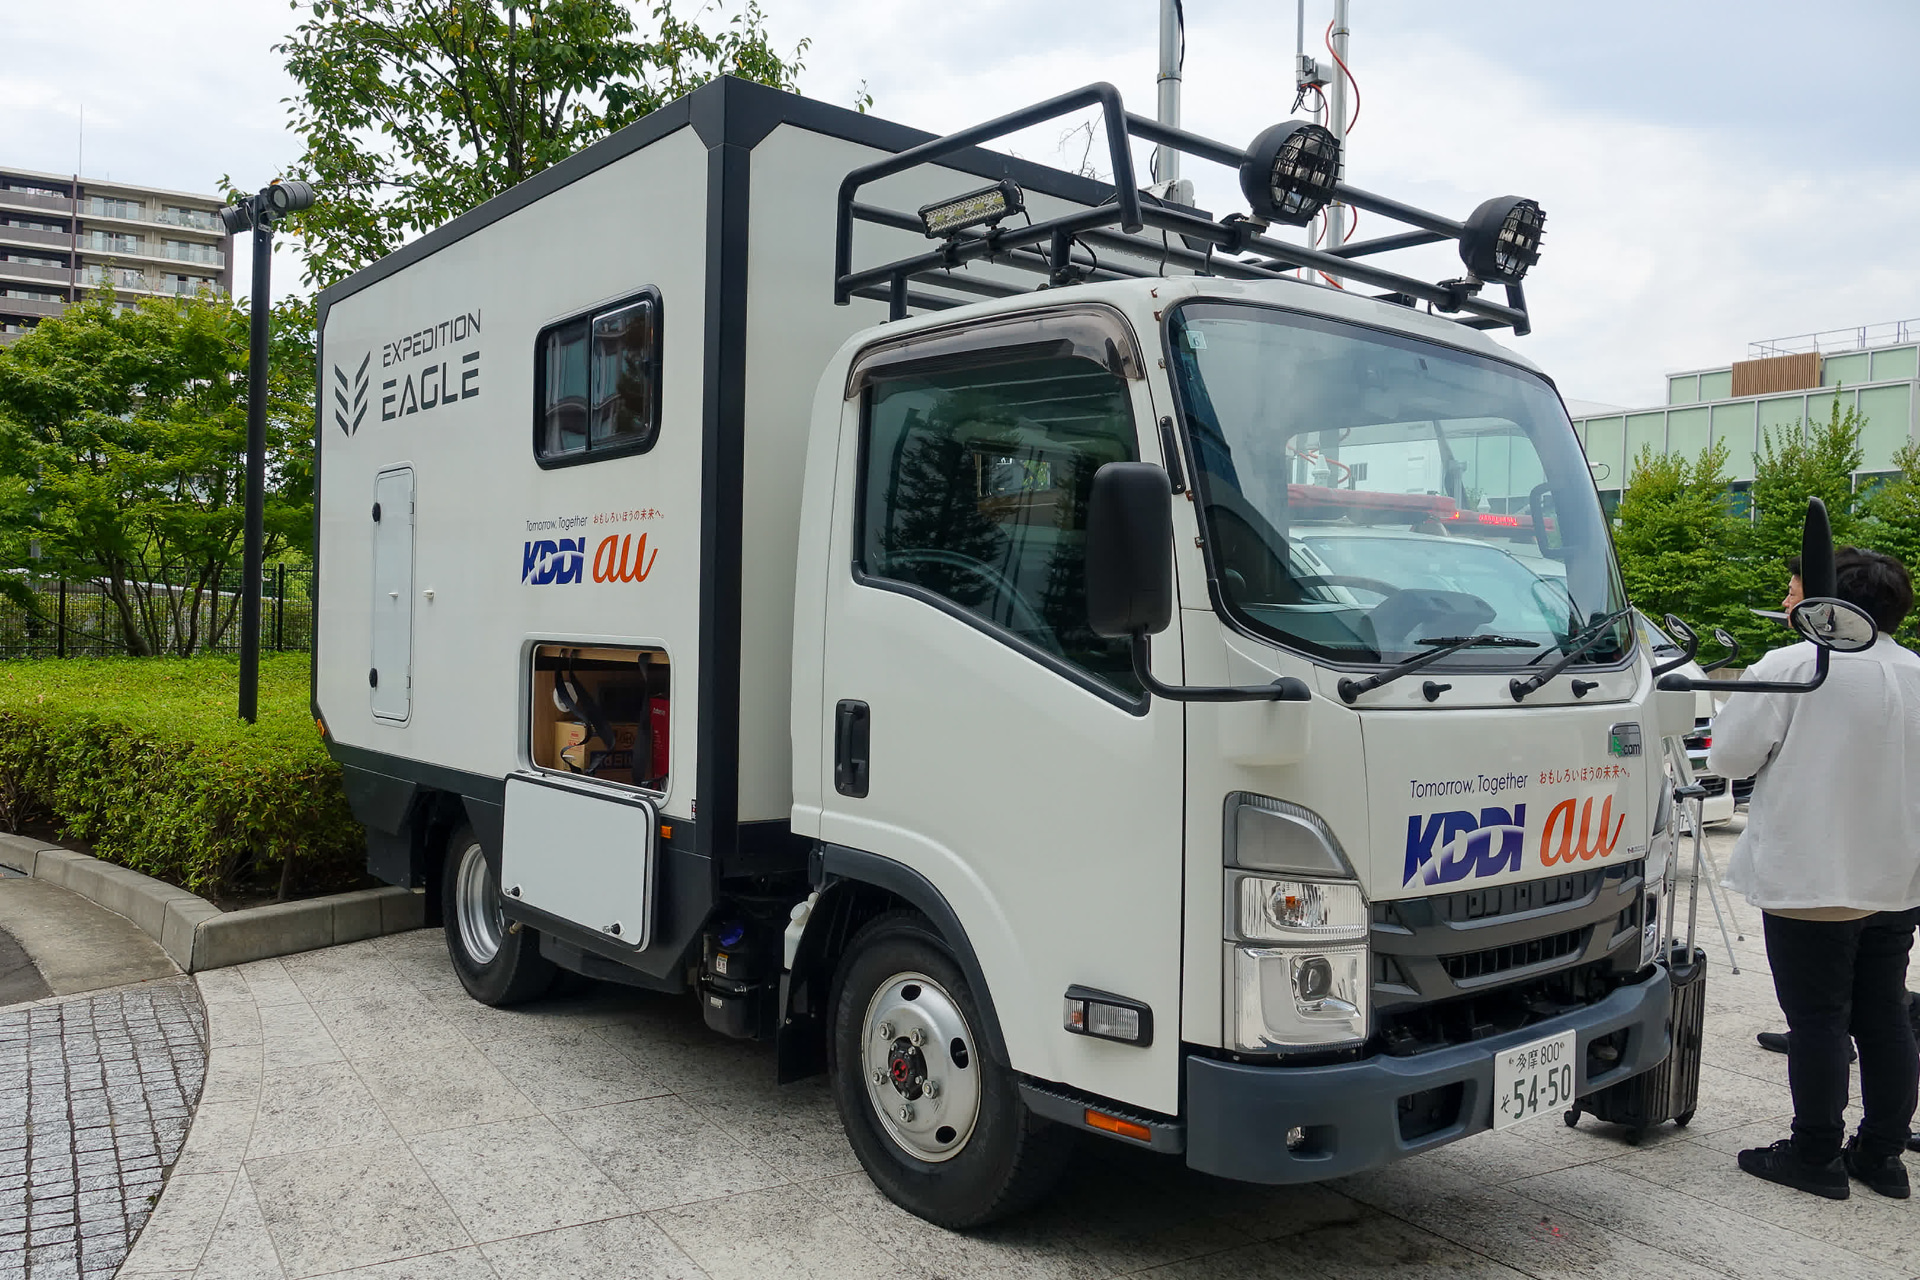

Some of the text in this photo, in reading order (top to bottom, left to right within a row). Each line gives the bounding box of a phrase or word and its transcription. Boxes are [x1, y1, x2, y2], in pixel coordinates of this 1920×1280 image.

[383, 308, 481, 367] EXPEDITION
[382, 351, 480, 422] EAGLE
[558, 516, 588, 531] Together
[593, 507, 665, 524] おもしろいほうの未来へ。
[521, 532, 658, 586] KDDI au
[1410, 772, 1528, 799] Tomorrow, Together
[1539, 764, 1631, 785] おもしろいほうの未来へ。
[1402, 794, 1626, 890] KDDI au
[1516, 1041, 1560, 1074] 多摩 800
[1500, 1063, 1572, 1120] そ 54-50
